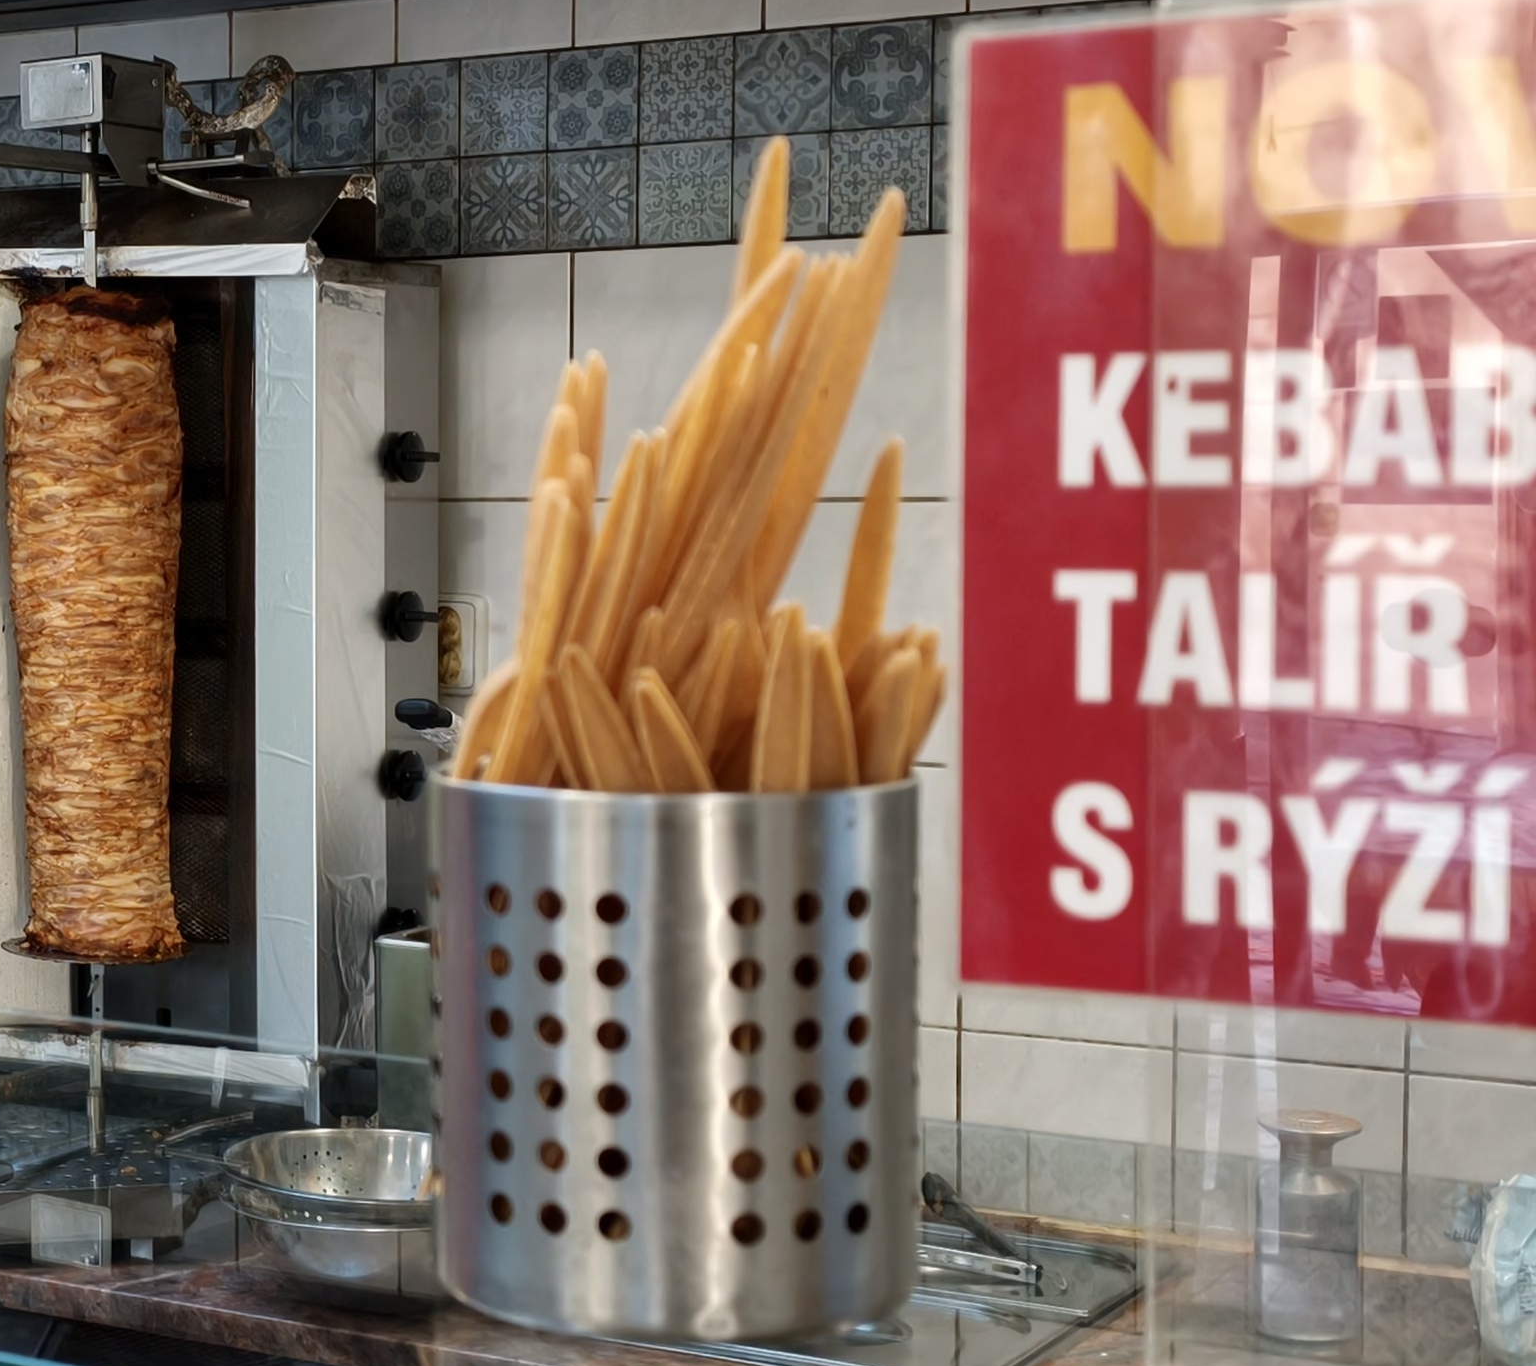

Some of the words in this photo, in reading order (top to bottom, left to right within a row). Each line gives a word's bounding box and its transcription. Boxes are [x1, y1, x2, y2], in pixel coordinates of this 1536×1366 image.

[1058, 346, 1536, 490] KEBAB
[1053, 533, 1470, 715] TALÍŘ
[1050, 779, 1134, 922] S
[1181, 756, 1528, 947] RÝŽÍ
